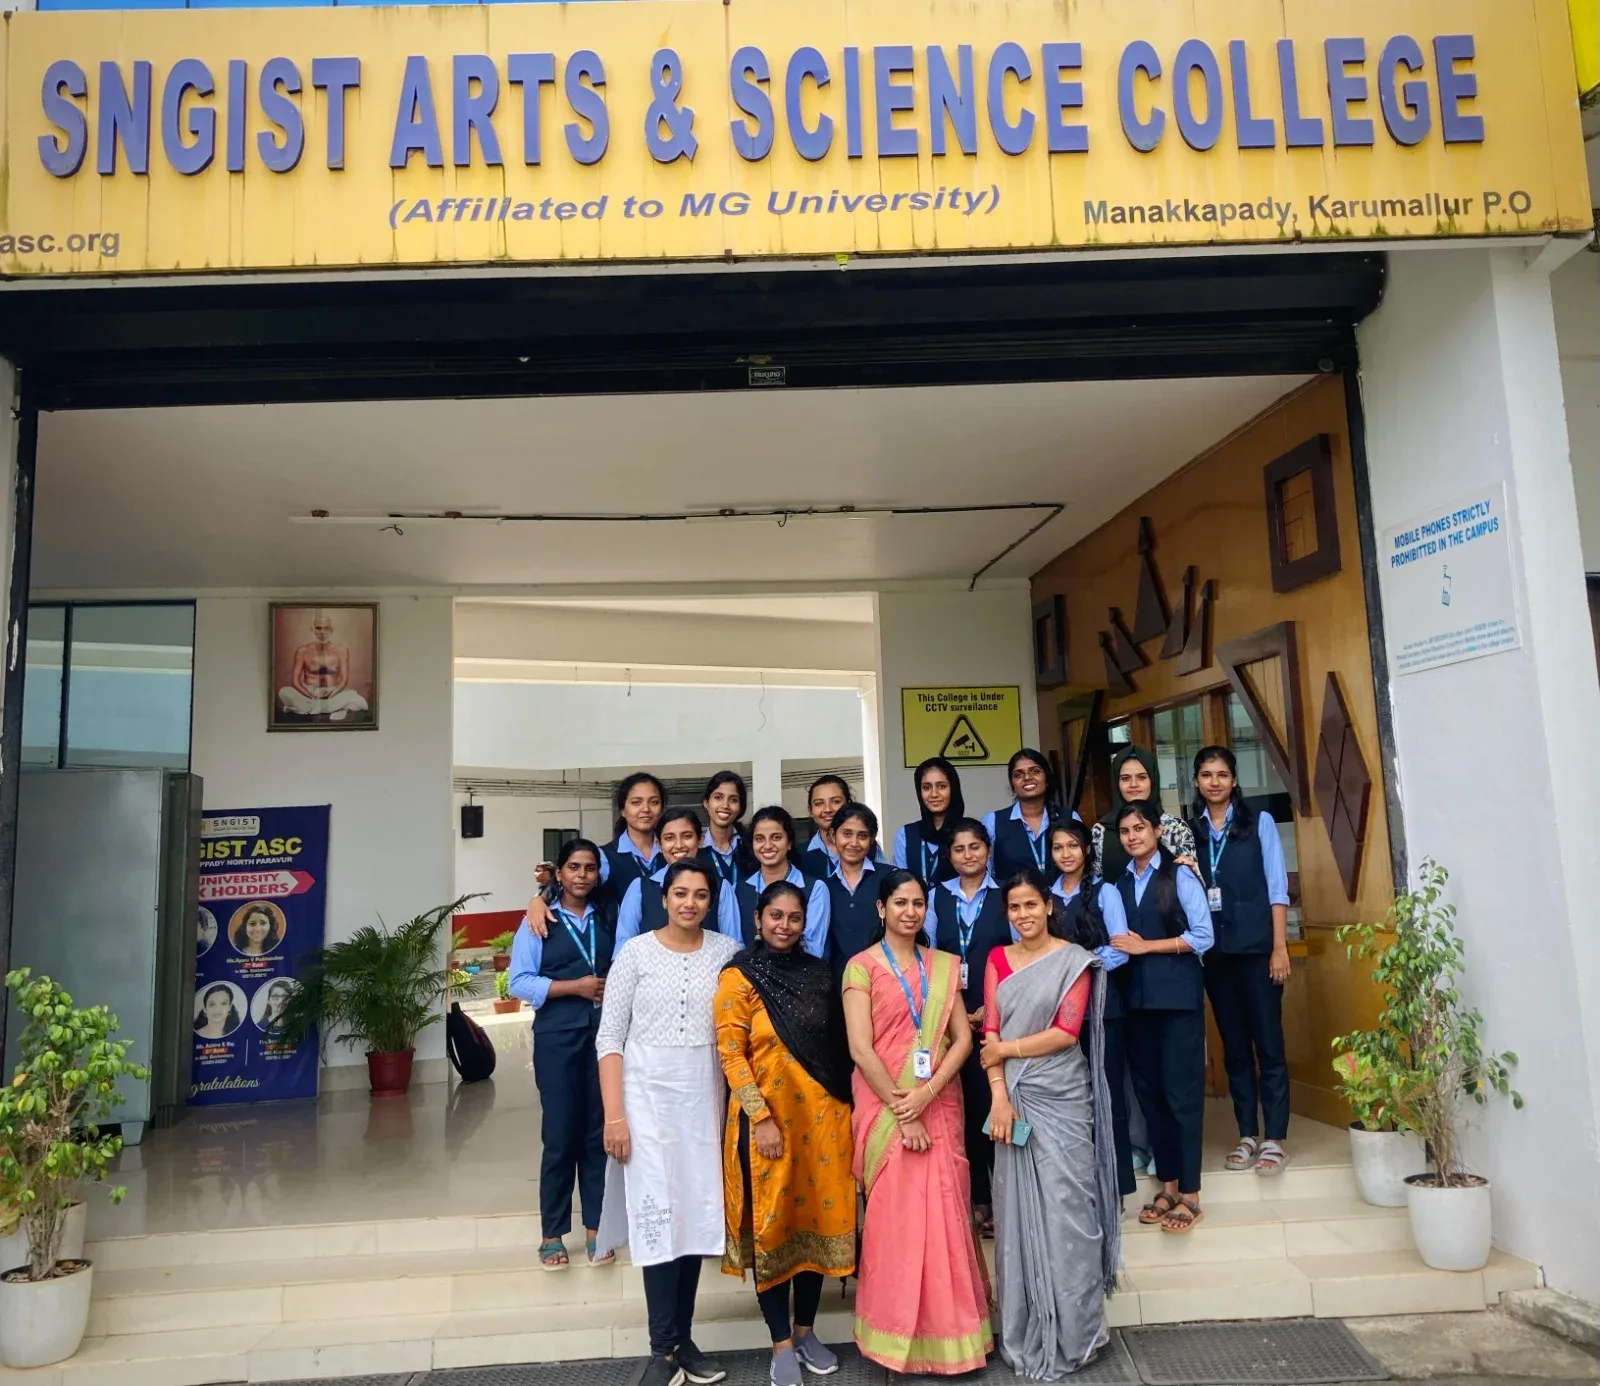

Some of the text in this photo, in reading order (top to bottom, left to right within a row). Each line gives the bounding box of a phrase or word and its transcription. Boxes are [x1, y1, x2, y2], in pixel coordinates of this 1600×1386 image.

[37, 34, 1485, 178] SNGIST ARTS & SCIENCE COLLEGE
[623, 195, 664, 218] to
[679, 192, 751, 217] MG
[767, 184, 1001, 216] University)
[1083, 190, 1532, 226] Manakkapady, Karumallur P.O
[0, 231, 120, 258] asc.org
[1394, 499, 1490, 549] MOBILE PHONES STRICTLY
[1390, 516, 1499, 569] PROHIBITTED IN THE CAMPUS
[917, 692, 1004, 703] This College is Under
[925, 703, 948, 712] CCTV
[213, 818, 257, 827] SNGIST
[251, 837, 302, 857] ASC
[226, 858, 255, 866] NORTH
[256, 856, 294, 865] PARAVUR
[211, 883, 290, 898] HOLDERS
